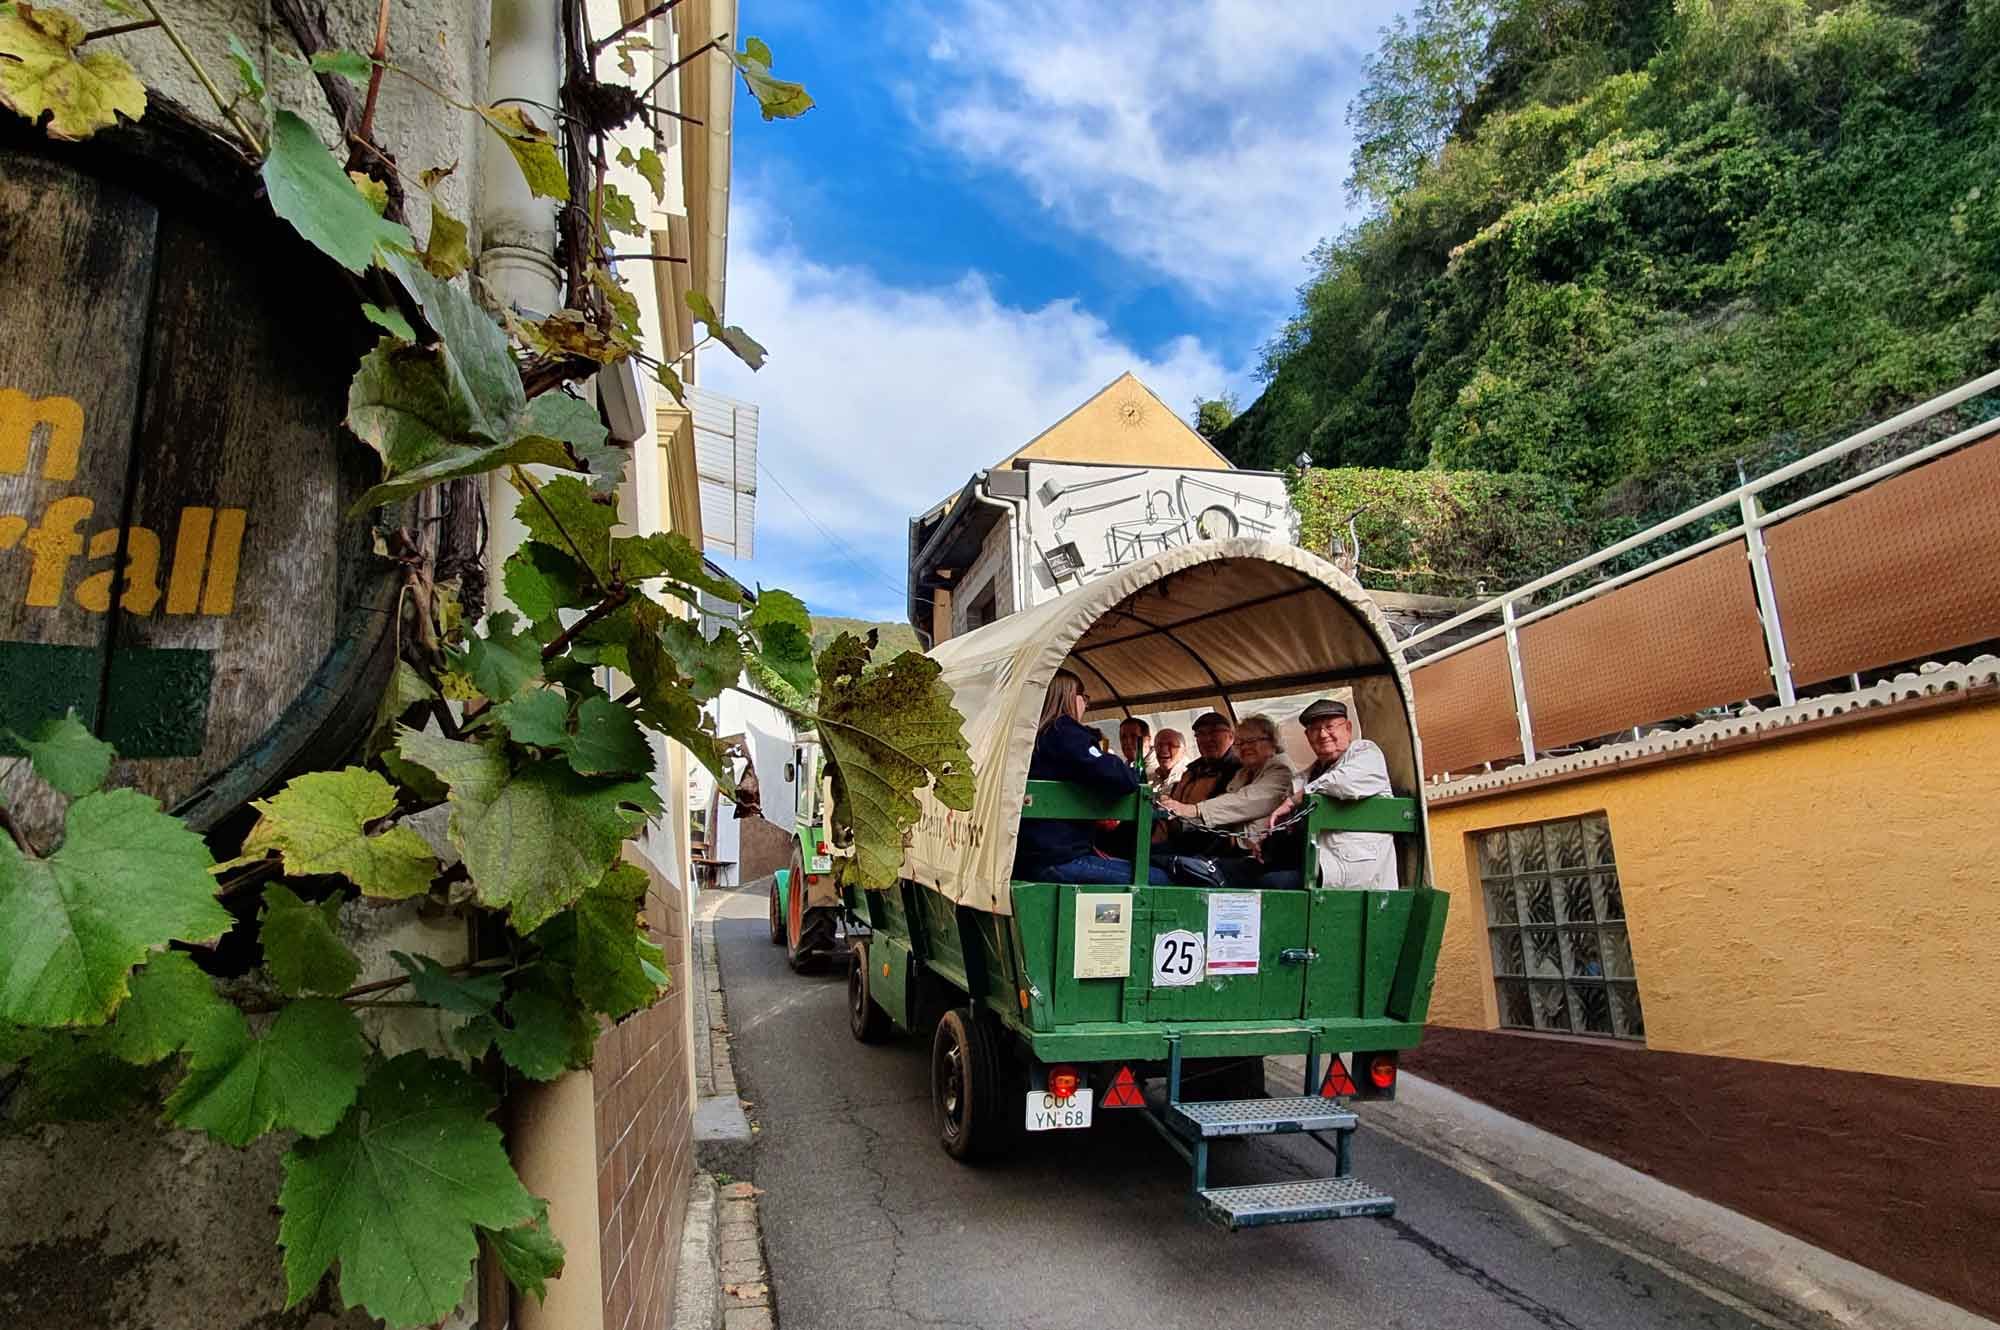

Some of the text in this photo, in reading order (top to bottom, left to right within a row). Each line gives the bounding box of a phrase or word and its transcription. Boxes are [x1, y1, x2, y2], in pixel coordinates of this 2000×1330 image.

[1161, 940, 1196, 975] 25
[1035, 1110, 1084, 1128] YN 68
